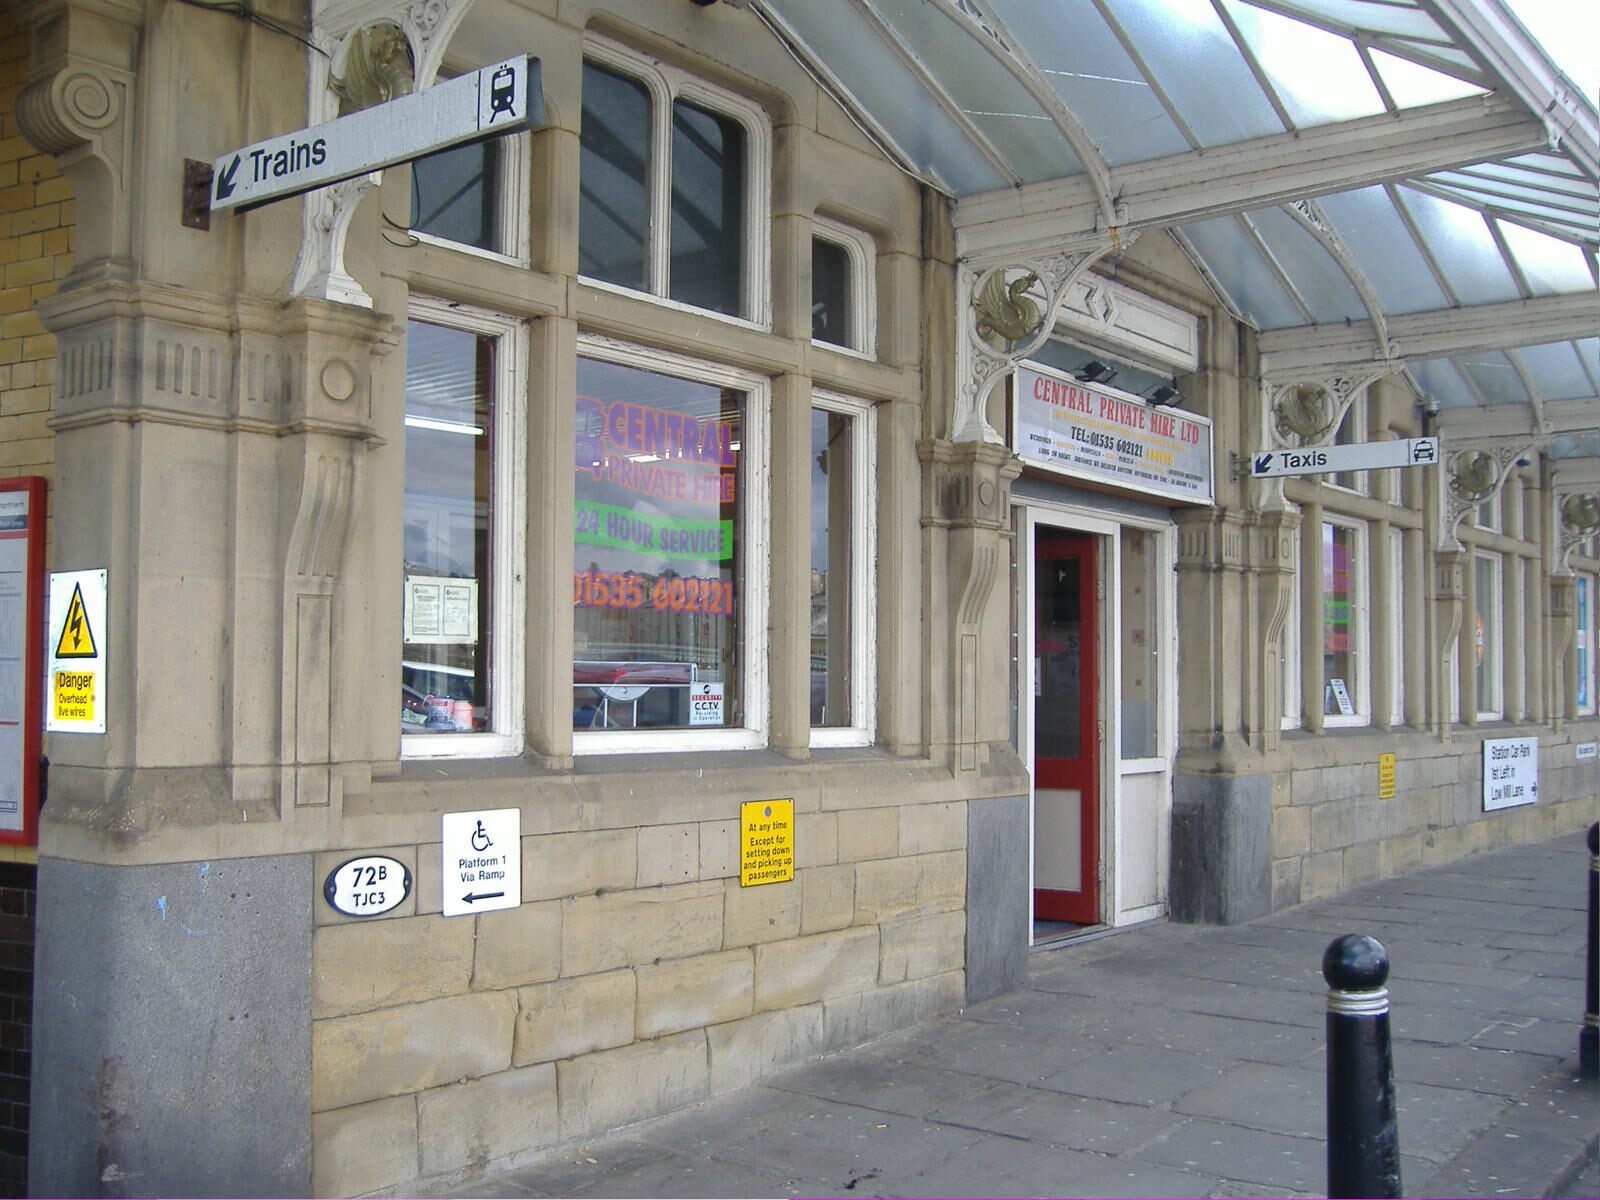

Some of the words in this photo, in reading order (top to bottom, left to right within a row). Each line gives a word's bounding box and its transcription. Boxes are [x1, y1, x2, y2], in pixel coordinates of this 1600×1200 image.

[250, 138, 326, 182] Trains
[1033, 376, 1093, 414] CENTRAL
[1099, 396, 1145, 430] PRIVATE
[1150, 410, 1176, 439] HIRE
[1181, 420, 1200, 445] LTD
[608, 400, 736, 468] CENTRAL
[1116, 439, 1143, 458] 602121
[1280, 451, 1327, 468] Taxis
[608, 455, 688, 500] PRIVATE
[691, 472, 735, 503] HIRE
[576, 507, 600, 535] 24
[606, 513, 654, 550] HOUR
[660, 529, 725, 554] SERVICE
[574, 570, 643, 609] 01535
[651, 575, 733, 616] 602121
[59, 672, 93, 690] Danger
[59, 693, 87, 704] Overhead
[695, 702, 720, 710] C.C.T.V.
[59, 706, 69, 716] live
[70, 706, 86, 716] wires
[1491, 745, 1510, 760] Station
[1511, 744, 1520, 758] Car
[1520, 743, 1531, 758] Park
[1500, 765, 1510, 779] Left
[1491, 787, 1502, 801] Low
[1512, 785, 1524, 797] Lane
[749, 823, 757, 832] At
[759, 823, 770, 832] any
[773, 821, 788, 830] time
[750, 836, 775, 846] Except
[776, 835, 786, 843] for
[746, 848, 771, 858] setting
[772, 846, 790, 855] down
[458, 858, 499, 870] Platform
[502, 855, 507, 865] 1
[744, 860, 757, 869] and
[758, 858, 783, 869] picking
[784, 857, 793, 866] up
[353, 866, 388, 888] 72B
[460, 872, 475, 882] Via
[478, 869, 506, 881] Ramp
[748, 869, 787, 881] passengers
[353, 891, 386, 907] TJC3
